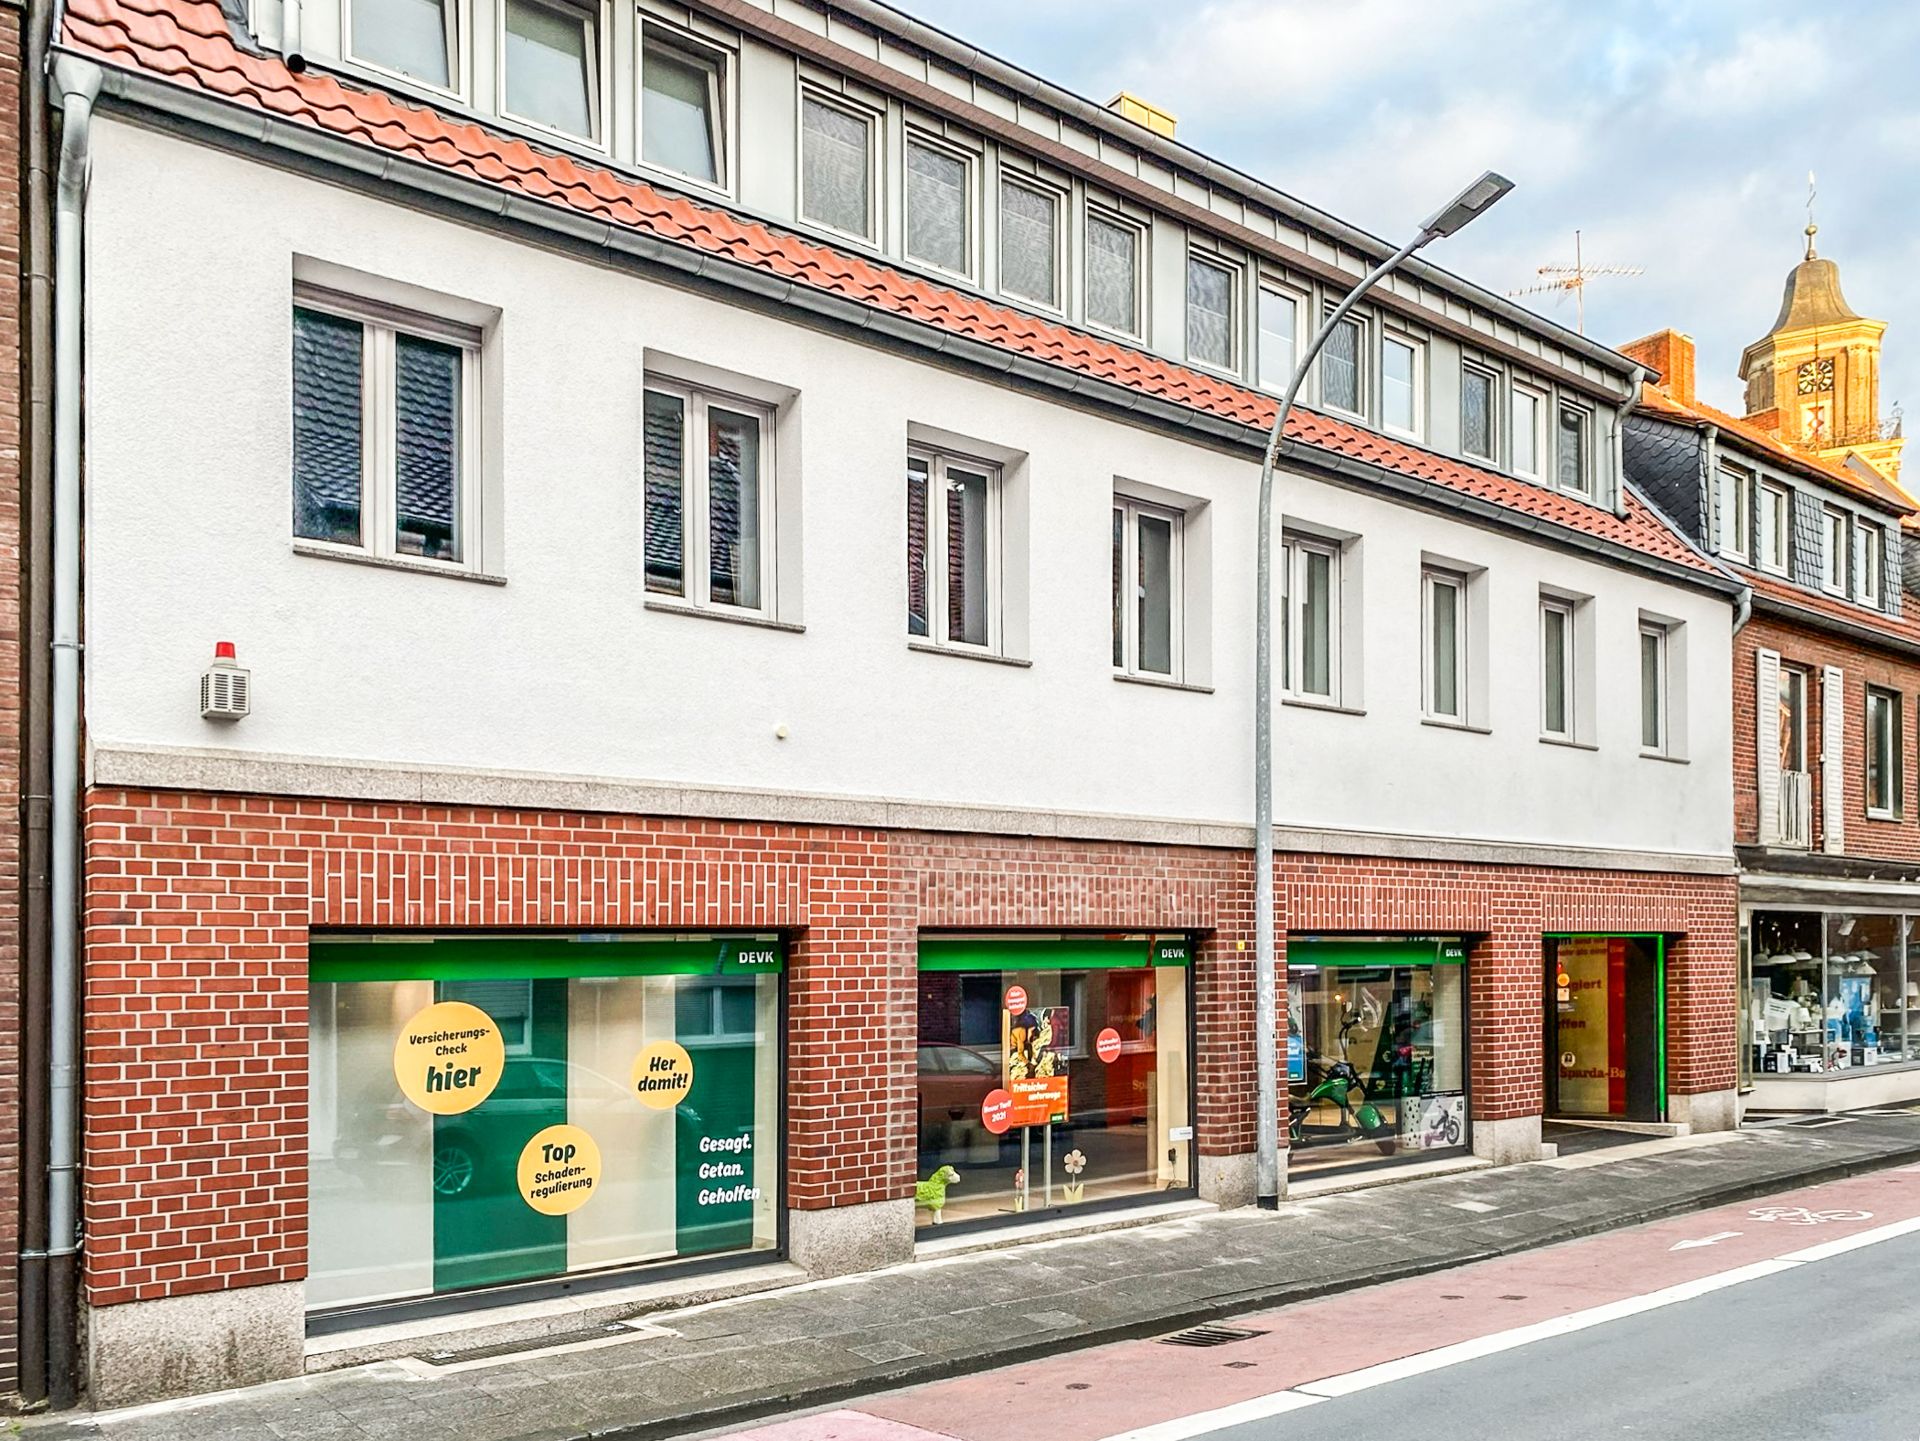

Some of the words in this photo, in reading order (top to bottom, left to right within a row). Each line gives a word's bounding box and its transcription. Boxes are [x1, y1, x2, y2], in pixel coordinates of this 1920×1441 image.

[738, 951, 774, 964] DEVK
[1161, 948, 1185, 959] DEVK
[1445, 948, 1463, 957] DEVK
[409, 1028, 490, 1045] Versicherungs-
[435, 1043, 467, 1056] Check
[649, 1056, 677, 1072] Her
[426, 1061, 481, 1093] hier
[637, 1072, 688, 1092] damit!
[1012, 1082, 1049, 1094] Trittsicher
[699, 1133, 752, 1154] Gesagt.
[542, 1143, 576, 1164] Top
[535, 1166, 586, 1184] Schaden-
[699, 1161, 745, 1179] Getan.
[530, 1177, 593, 1199] regulierung
